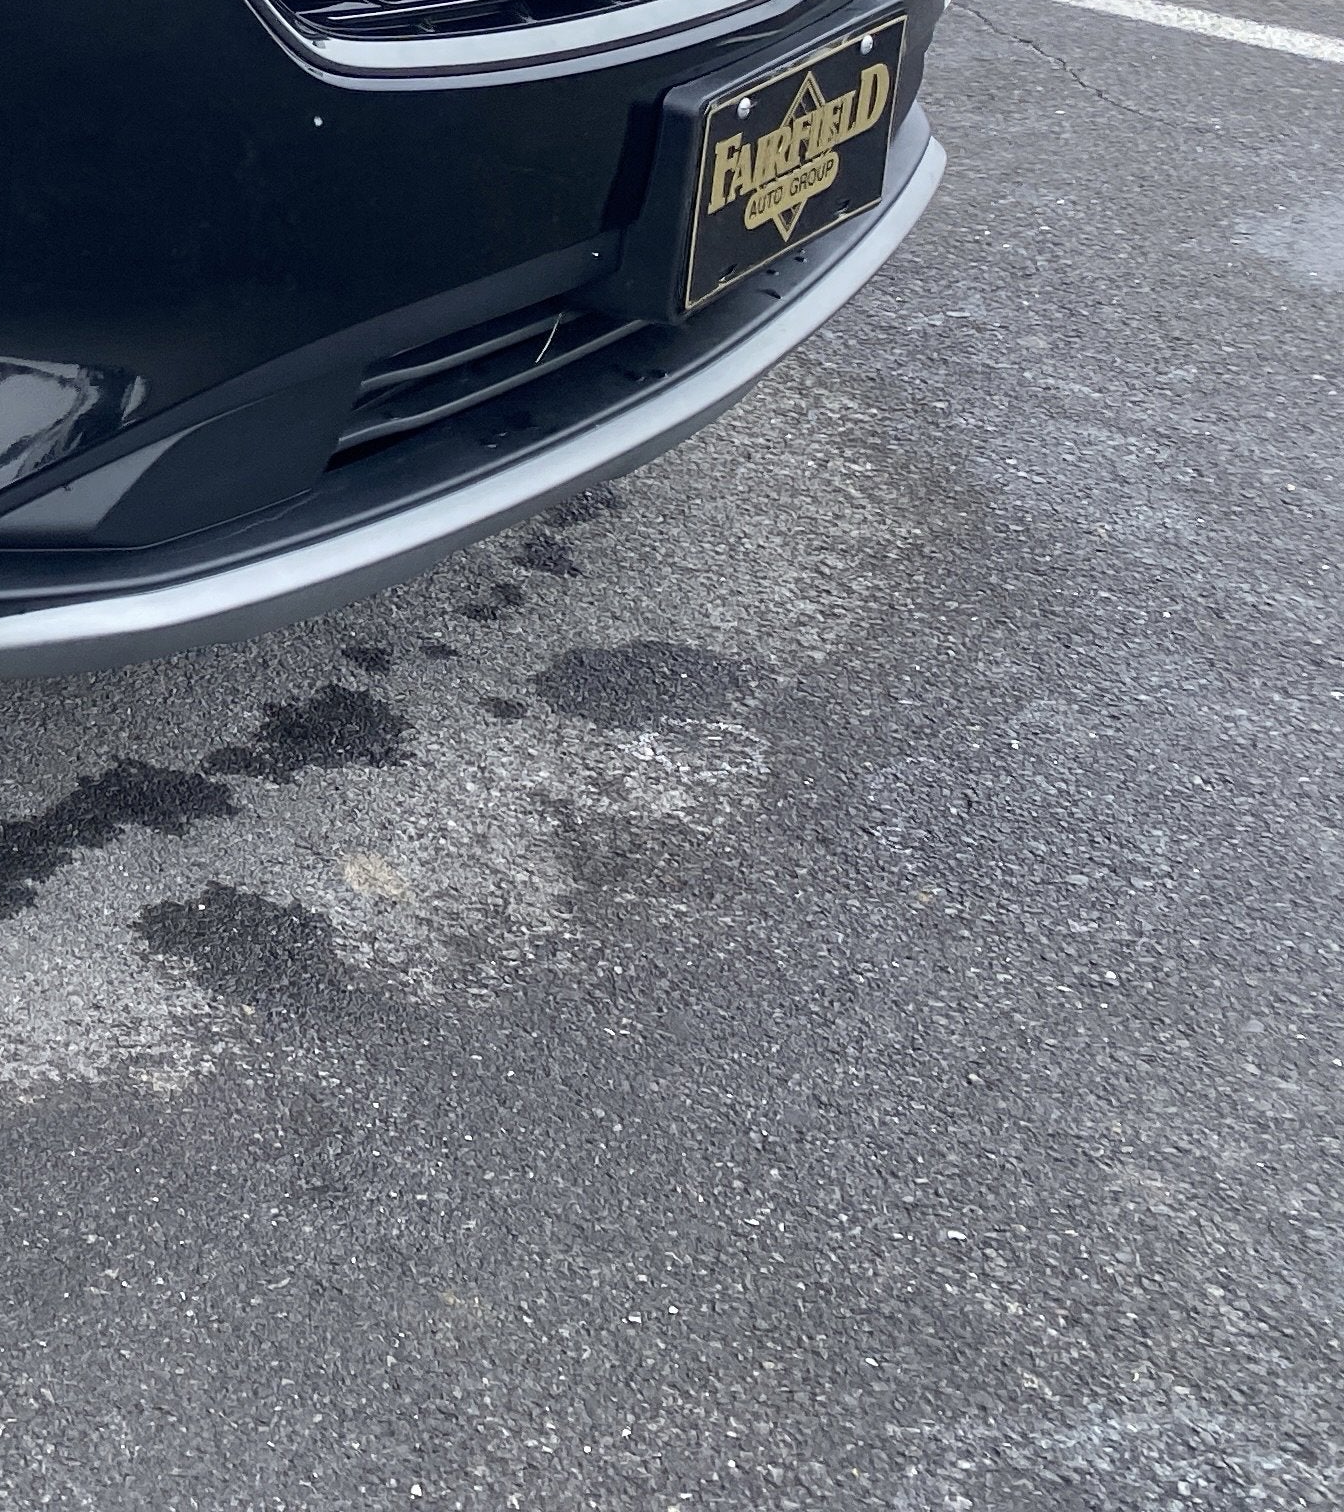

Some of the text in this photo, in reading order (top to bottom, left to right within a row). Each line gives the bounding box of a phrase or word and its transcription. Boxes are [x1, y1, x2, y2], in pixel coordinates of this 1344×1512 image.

[708, 63, 890, 215] FAIRFIELD
[748, 158, 834, 221] AUTO GROUP
